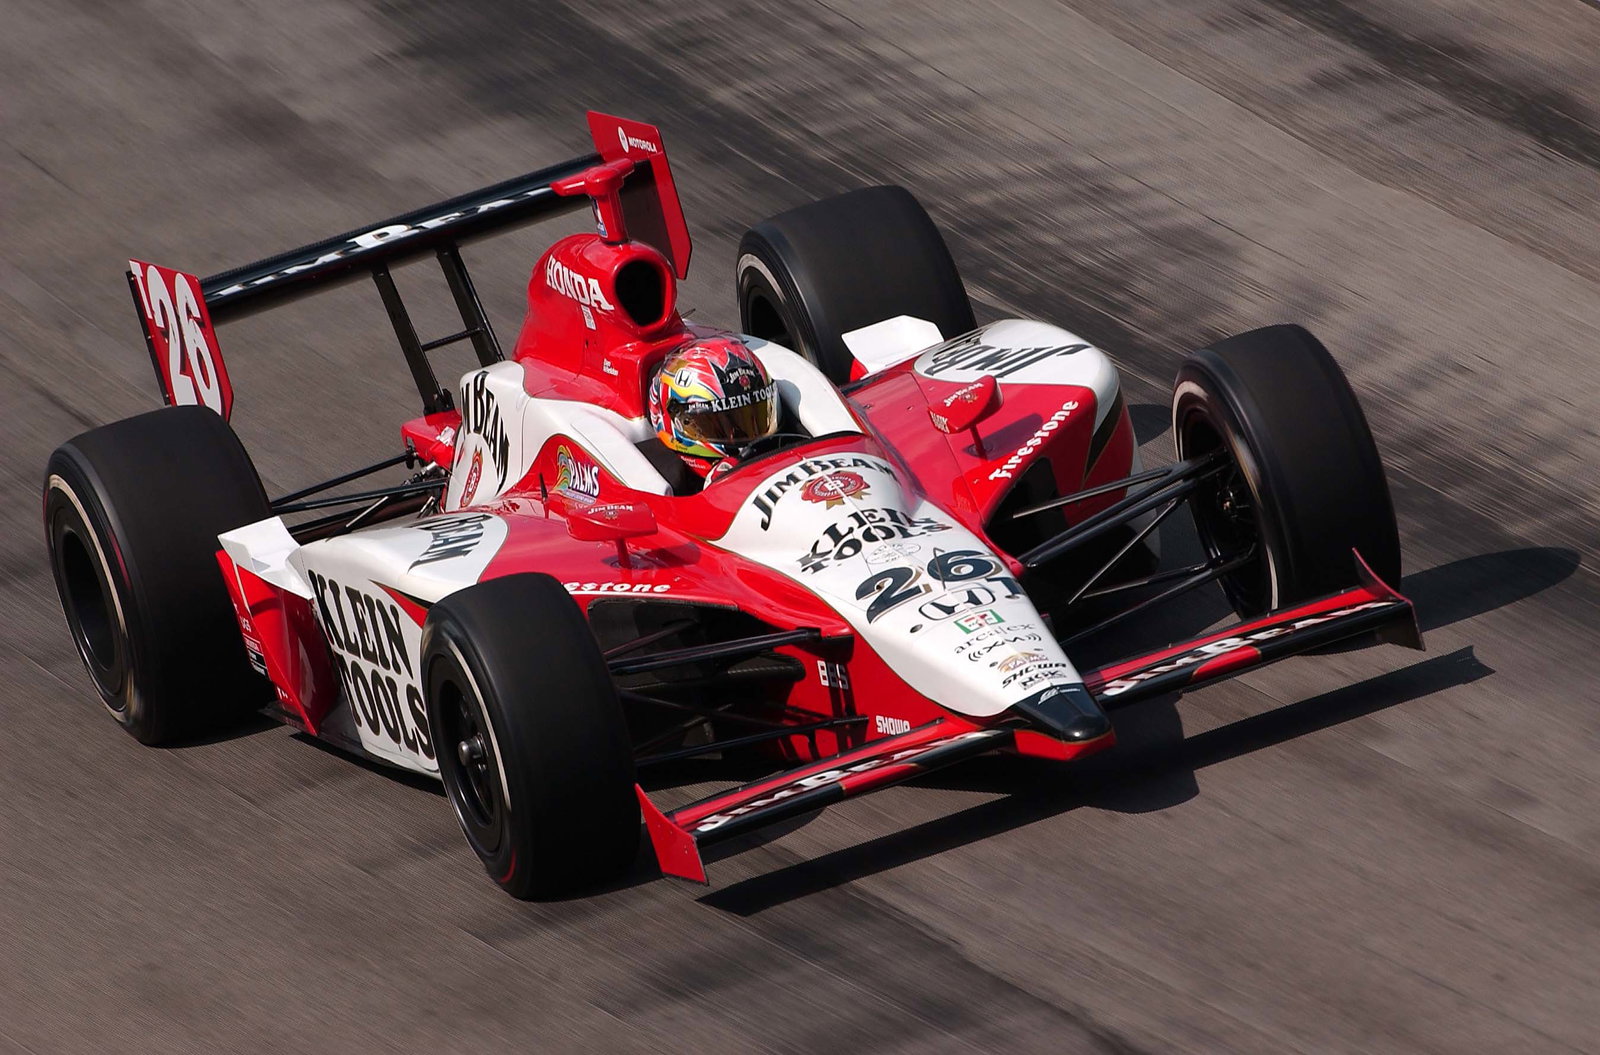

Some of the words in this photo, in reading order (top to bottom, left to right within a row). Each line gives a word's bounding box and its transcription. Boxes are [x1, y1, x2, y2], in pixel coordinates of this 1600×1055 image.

[628, 136, 658, 153] MOTOROLA
[546, 254, 615, 310] HONDA
[711, 393, 752, 412] KLEIN
[989, 400, 1079, 481] Firestone
[568, 458, 600, 497] PALMS
[752, 471, 801, 532] JIM
[800, 457, 899, 482] BEAM
[588, 506, 606, 515] JIM
[797, 508, 939, 568] KLEIN
[801, 523, 953, 576] TOOLS
[564, 581, 671, 594] estone
[855, 550, 1003, 625] 26
[308, 568, 414, 681] KLEIN
[817, 660, 849, 690] BBS
[332, 652, 436, 761] TOOLS
